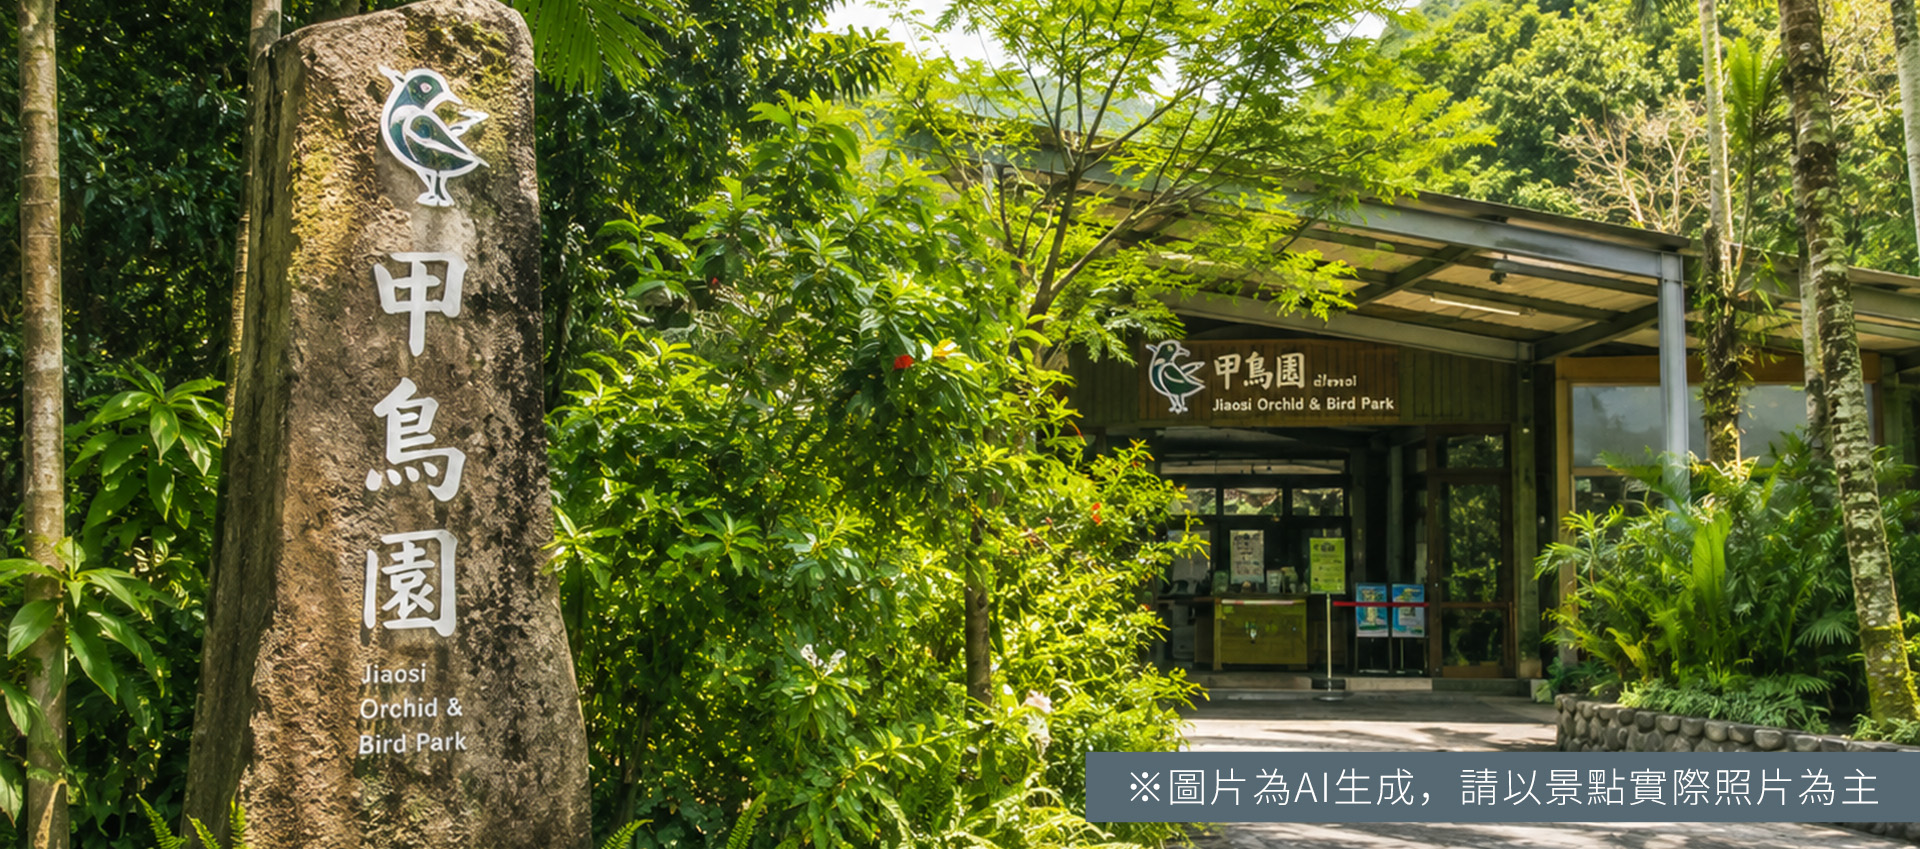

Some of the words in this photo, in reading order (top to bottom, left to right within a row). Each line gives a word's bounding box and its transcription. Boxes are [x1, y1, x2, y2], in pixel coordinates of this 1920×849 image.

[1212, 397, 1252, 411] Jiaosi
[1309, 397, 1321, 410] &
[1326, 396, 1356, 410] Bird
[1361, 396, 1394, 410] Park
[365, 251, 468, 638] 甲鳥園
[361, 662, 426, 684] Jiaosi
[360, 697, 438, 719] Orchid
[446, 697, 463, 717] &
[358, 732, 407, 754] Bird
[416, 731, 467, 752] Park
